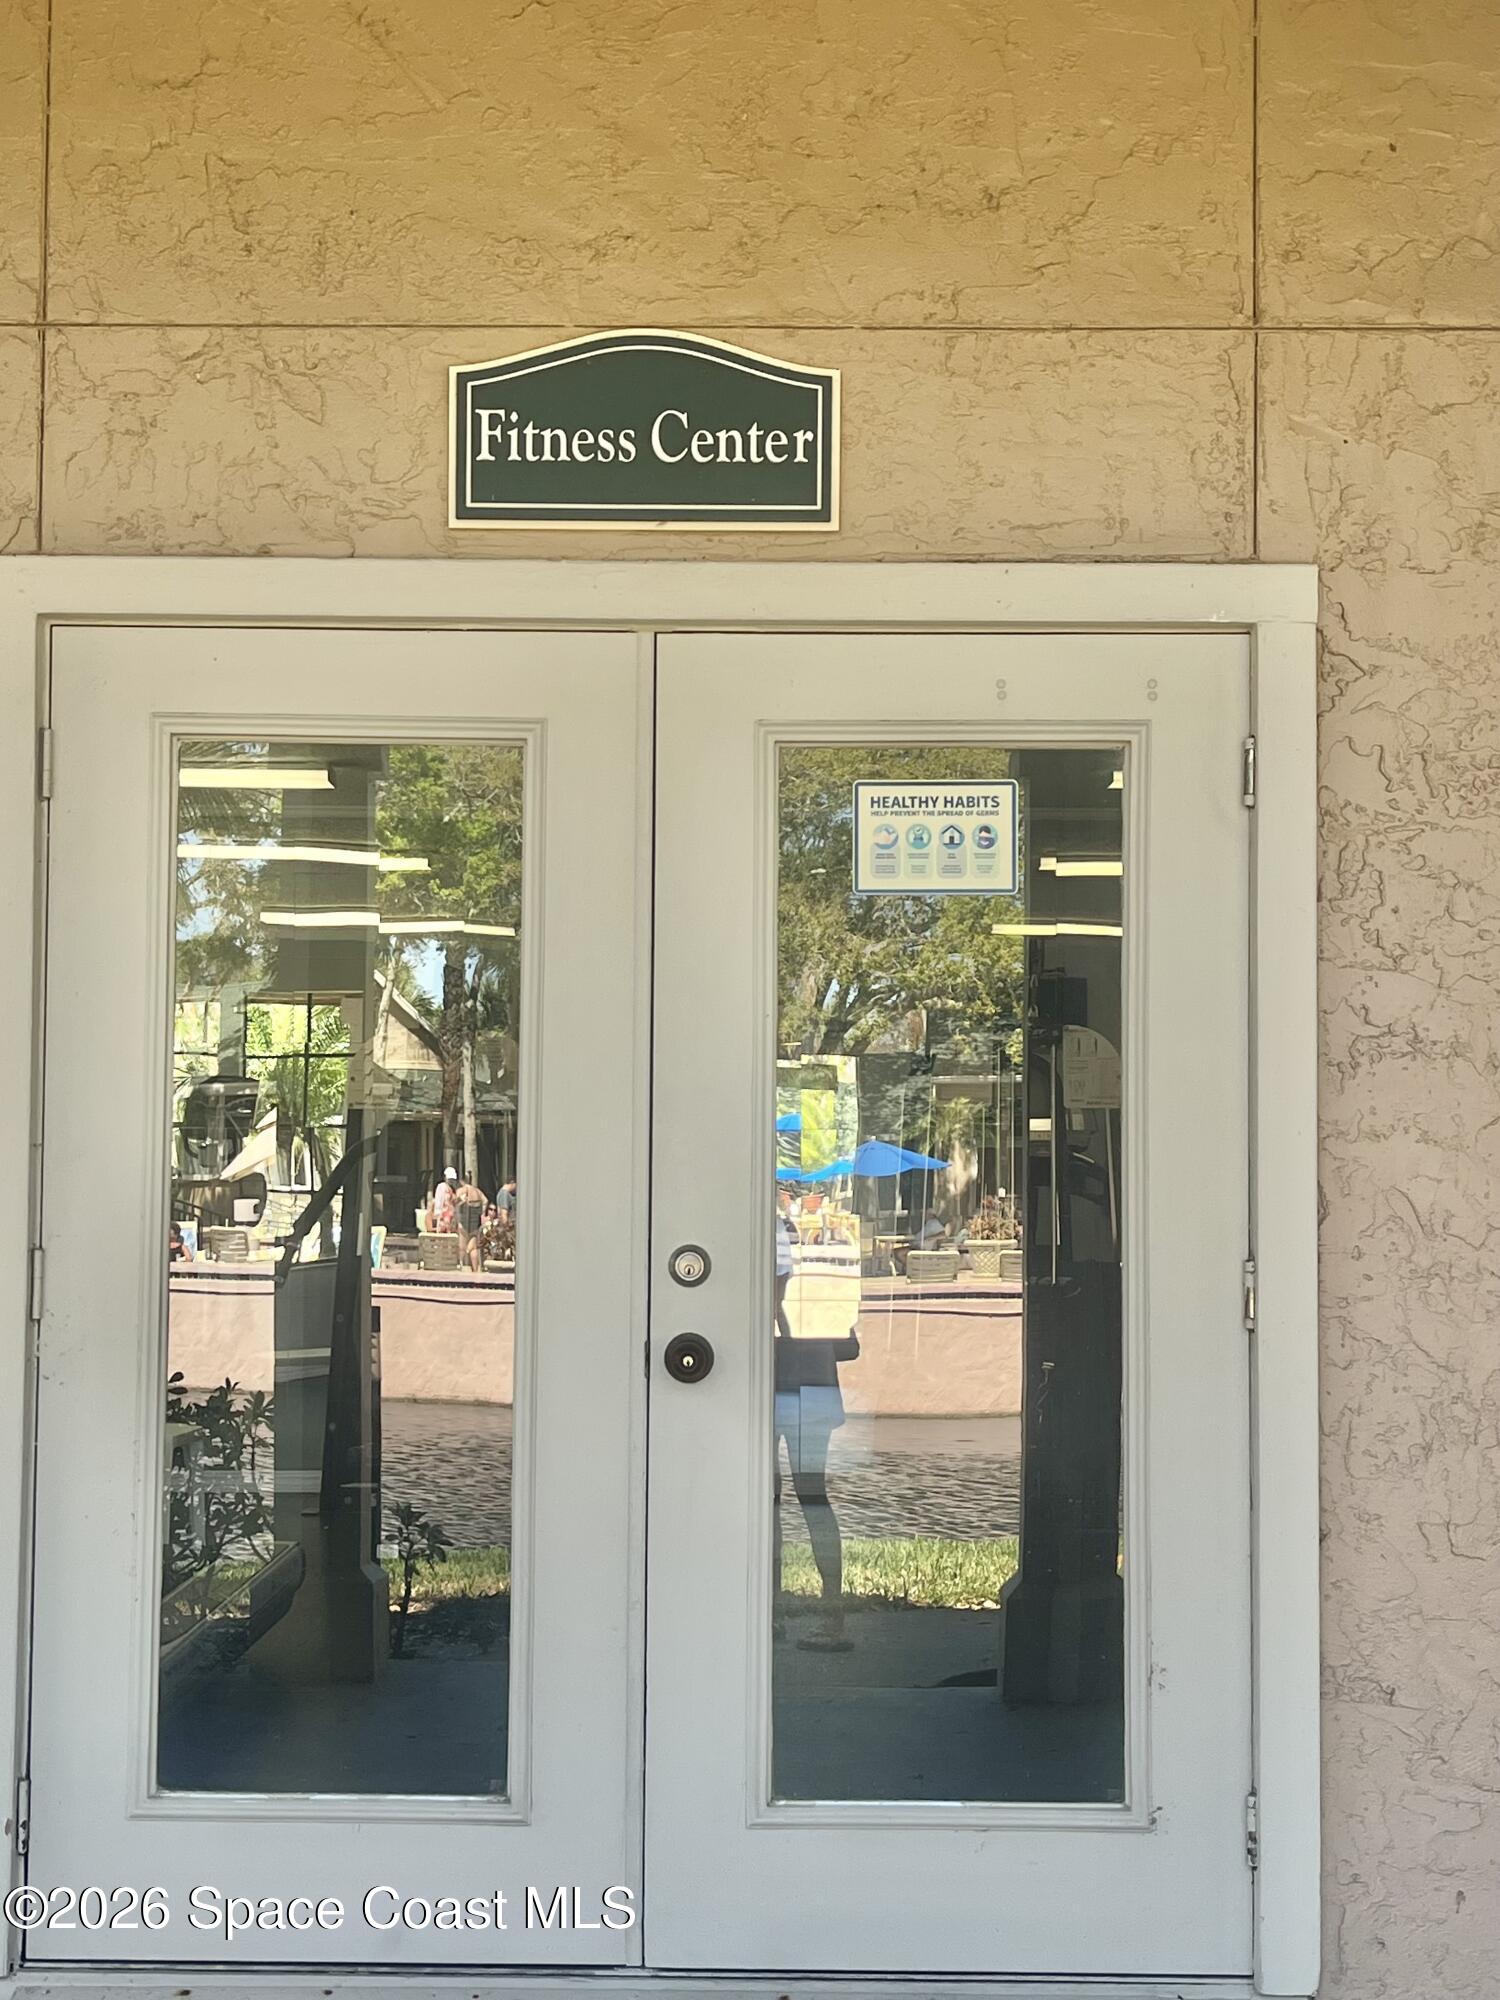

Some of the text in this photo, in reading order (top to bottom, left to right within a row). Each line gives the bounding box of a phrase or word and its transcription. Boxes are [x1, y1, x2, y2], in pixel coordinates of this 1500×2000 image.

[474, 408, 814, 463] Fitness Center
[870, 796, 1000, 809] HEALTHY HABITS
